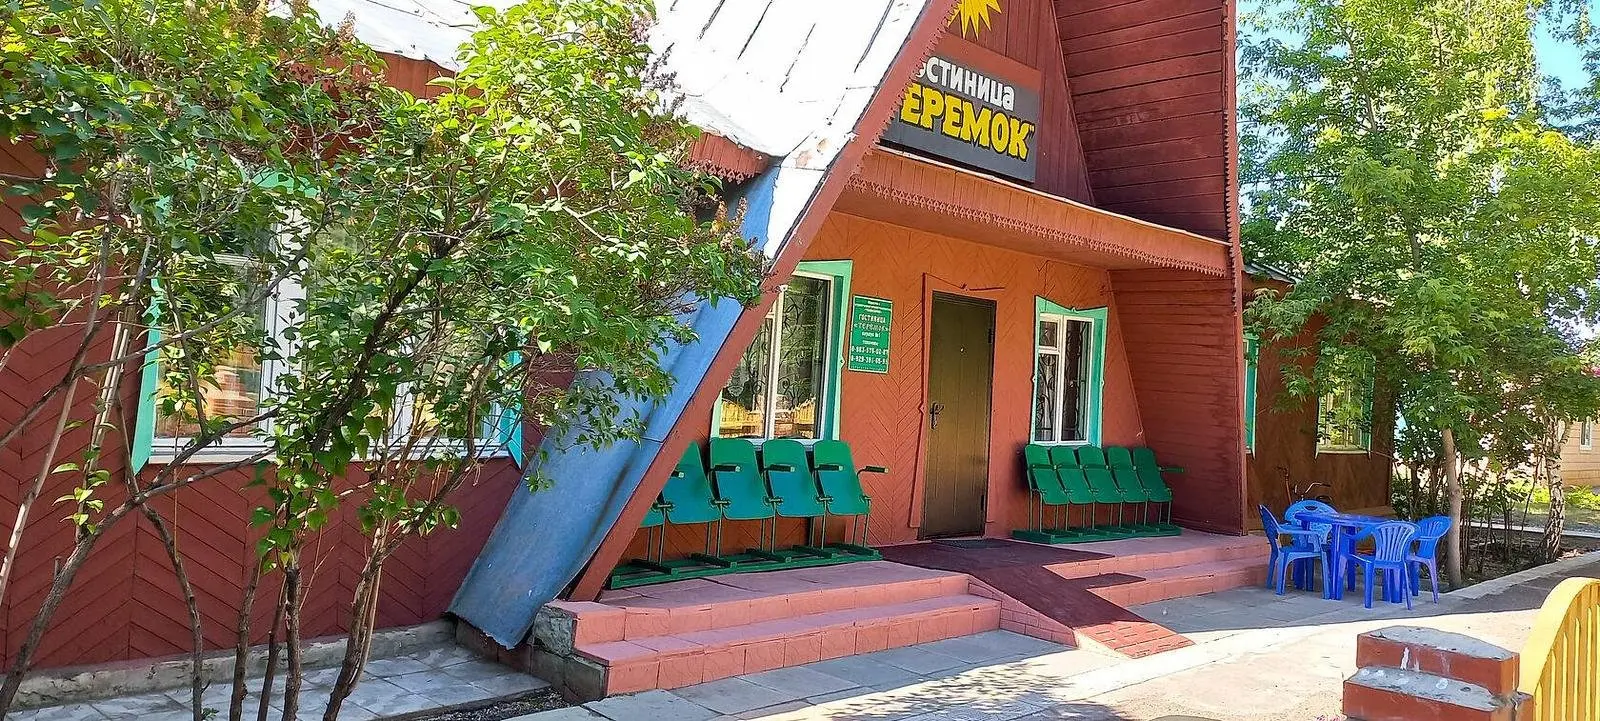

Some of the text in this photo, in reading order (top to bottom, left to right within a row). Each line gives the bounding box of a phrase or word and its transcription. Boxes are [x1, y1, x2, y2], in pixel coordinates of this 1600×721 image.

[915, 56, 1016, 111] стиница
[900, 82, 1036, 161] ЕРЕМОК"
[858, 313, 886, 324] ГОСТИНИЦА
